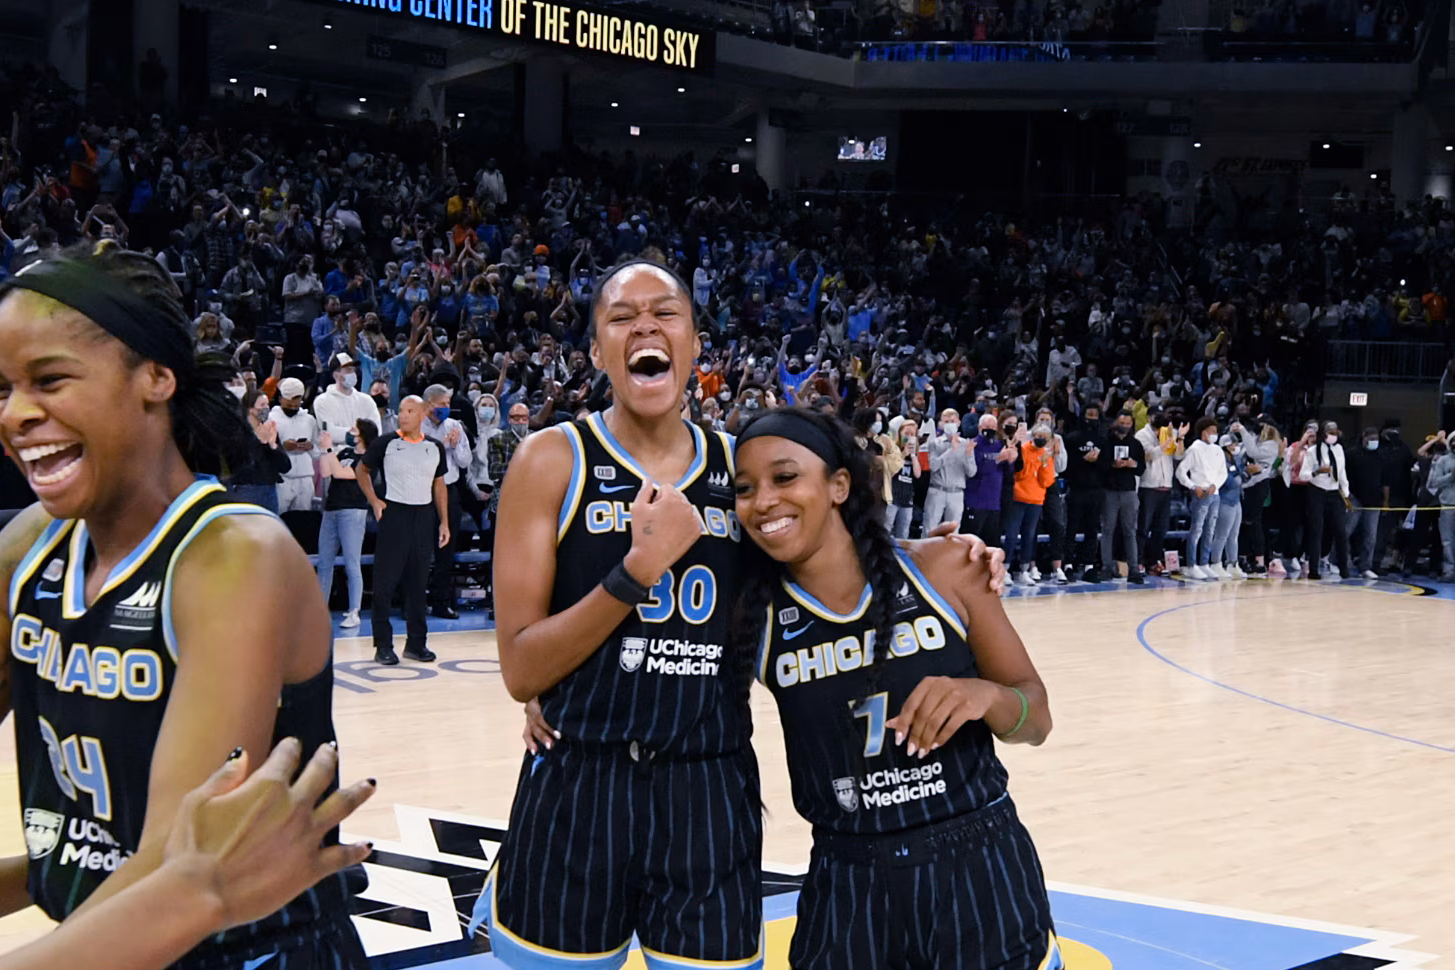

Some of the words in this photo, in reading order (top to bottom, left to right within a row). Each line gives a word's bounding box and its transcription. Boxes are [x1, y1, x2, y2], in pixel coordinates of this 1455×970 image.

[500, 0, 527, 35] OF
[532, 1, 571, 44] THE
[576, 10, 659, 61] CHICAGO
[663, 28, 699, 69] SKY
[585, 500, 741, 543] CHGO
[636, 564, 717, 624] 30
[646, 656, 720, 676] Medicin
[862, 779, 946, 810] Medicine
